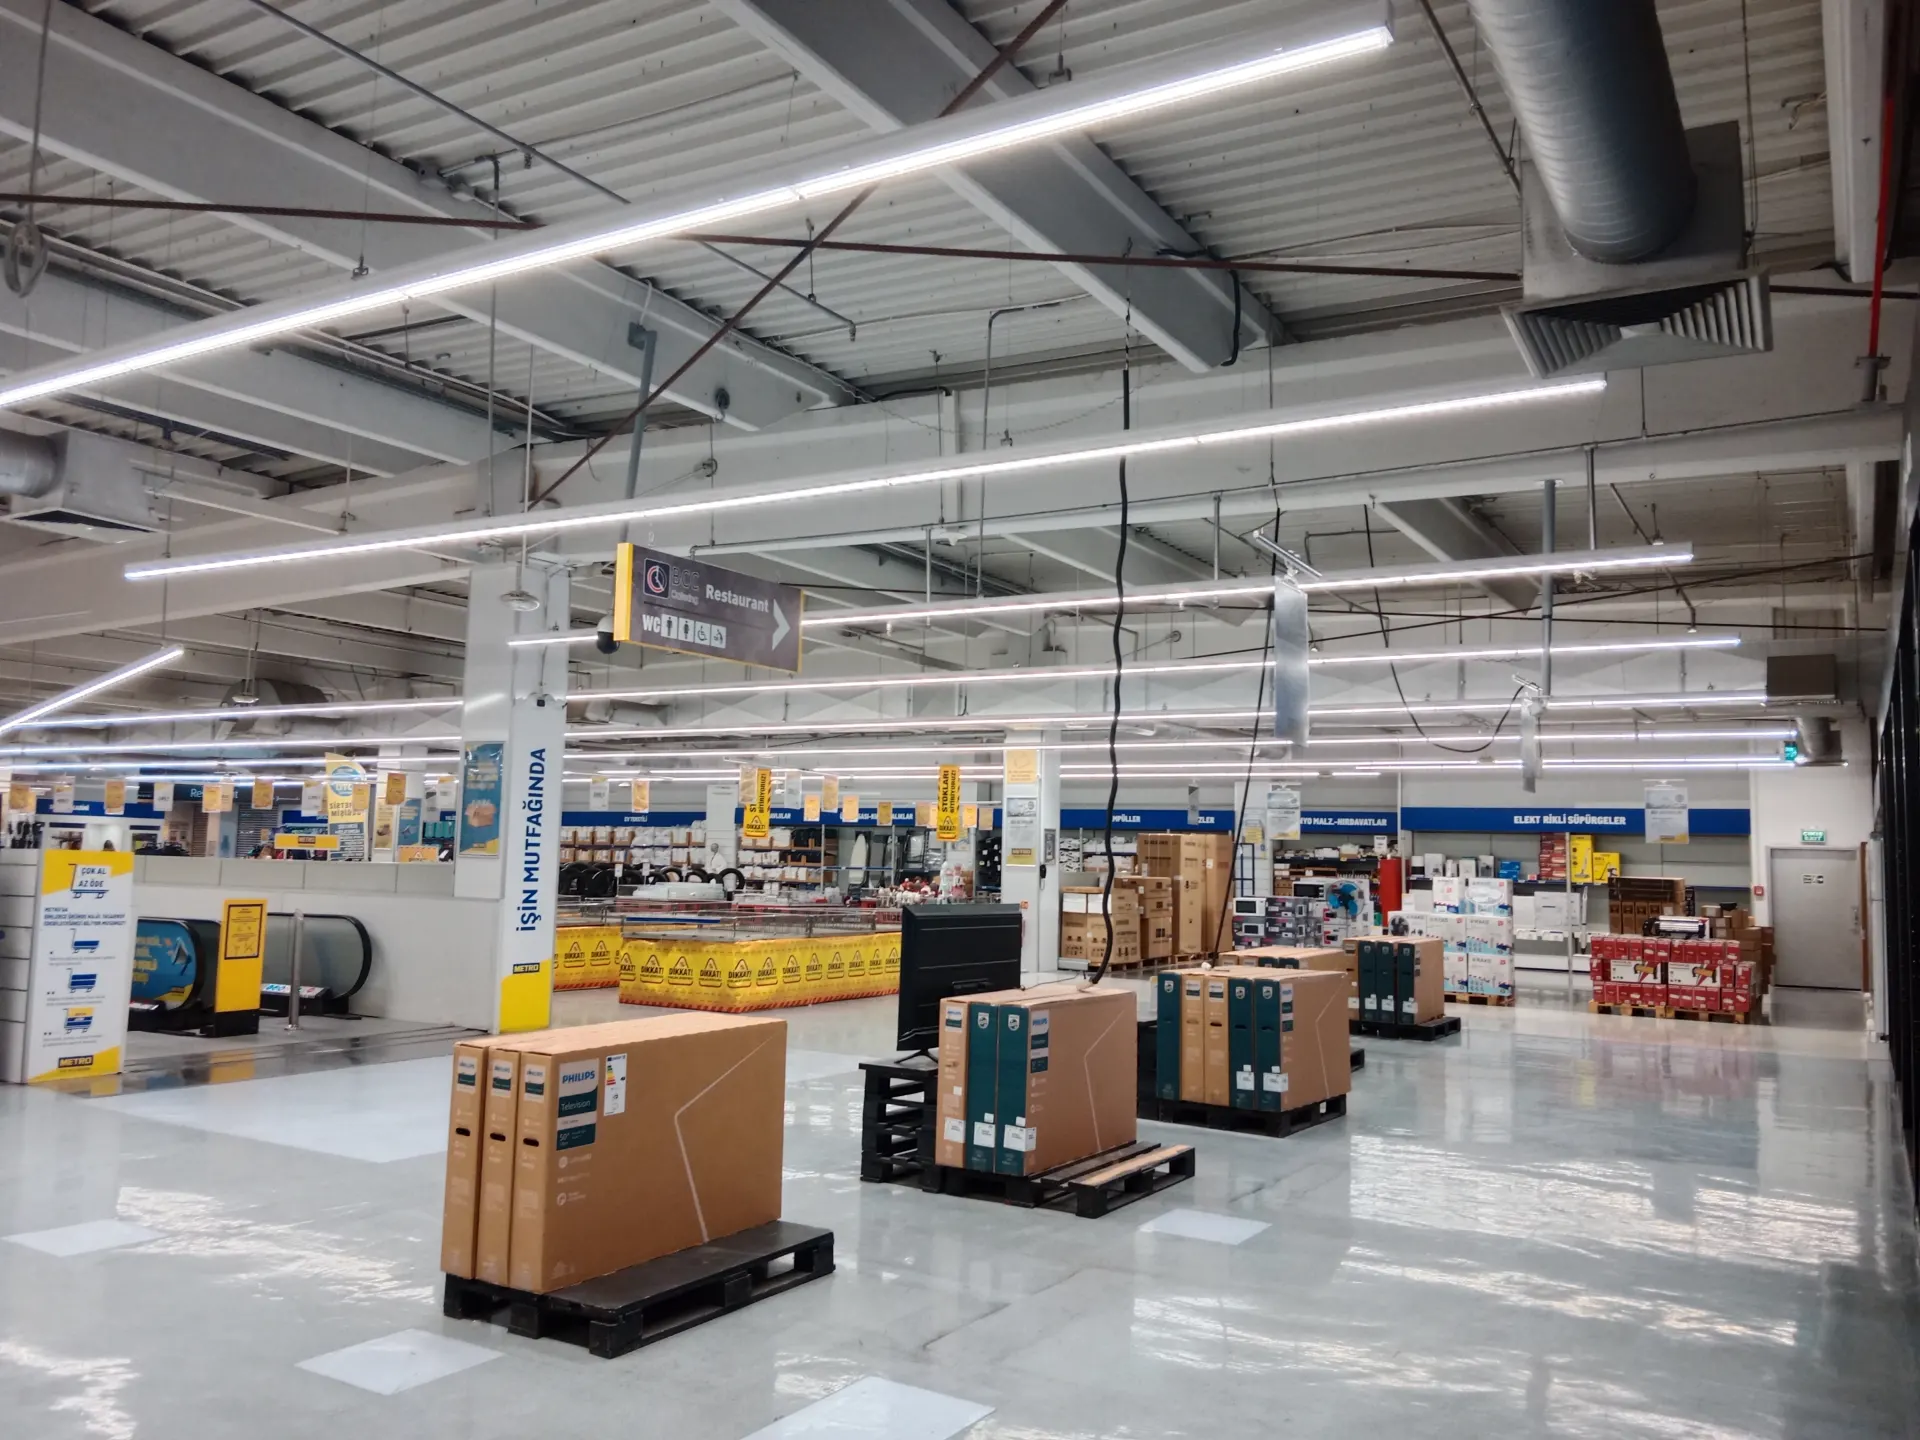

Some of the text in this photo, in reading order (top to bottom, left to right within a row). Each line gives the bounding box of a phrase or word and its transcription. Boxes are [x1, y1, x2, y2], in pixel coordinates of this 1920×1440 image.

[672, 566, 700, 590] BCC
[705, 584, 769, 613] Restaurant
[1112, 814, 1141, 822] MPÜLLER
[1514, 813, 1626, 825] ELEKT RİKLİ SÜPÜRGELER
[516, 748, 546, 931] İŞİN MUTFAĞINDA
[81, 868, 95, 876] ÇOK
[90, 879, 104, 887] ÖDE
[514, 964, 539, 972] METRO
[641, 965, 664, 974] DİKKAT!
[669, 967, 693, 976] DİKKAT!
[758, 968, 776, 977] DİKKAT!
[700, 969, 721, 978] DİKKAT!
[728, 970, 752, 978] DİKKAT!
[60, 1056, 92, 1067] METRO
[562, 1071, 595, 1084] PHILIPS
[561, 1100, 591, 1111] Television
